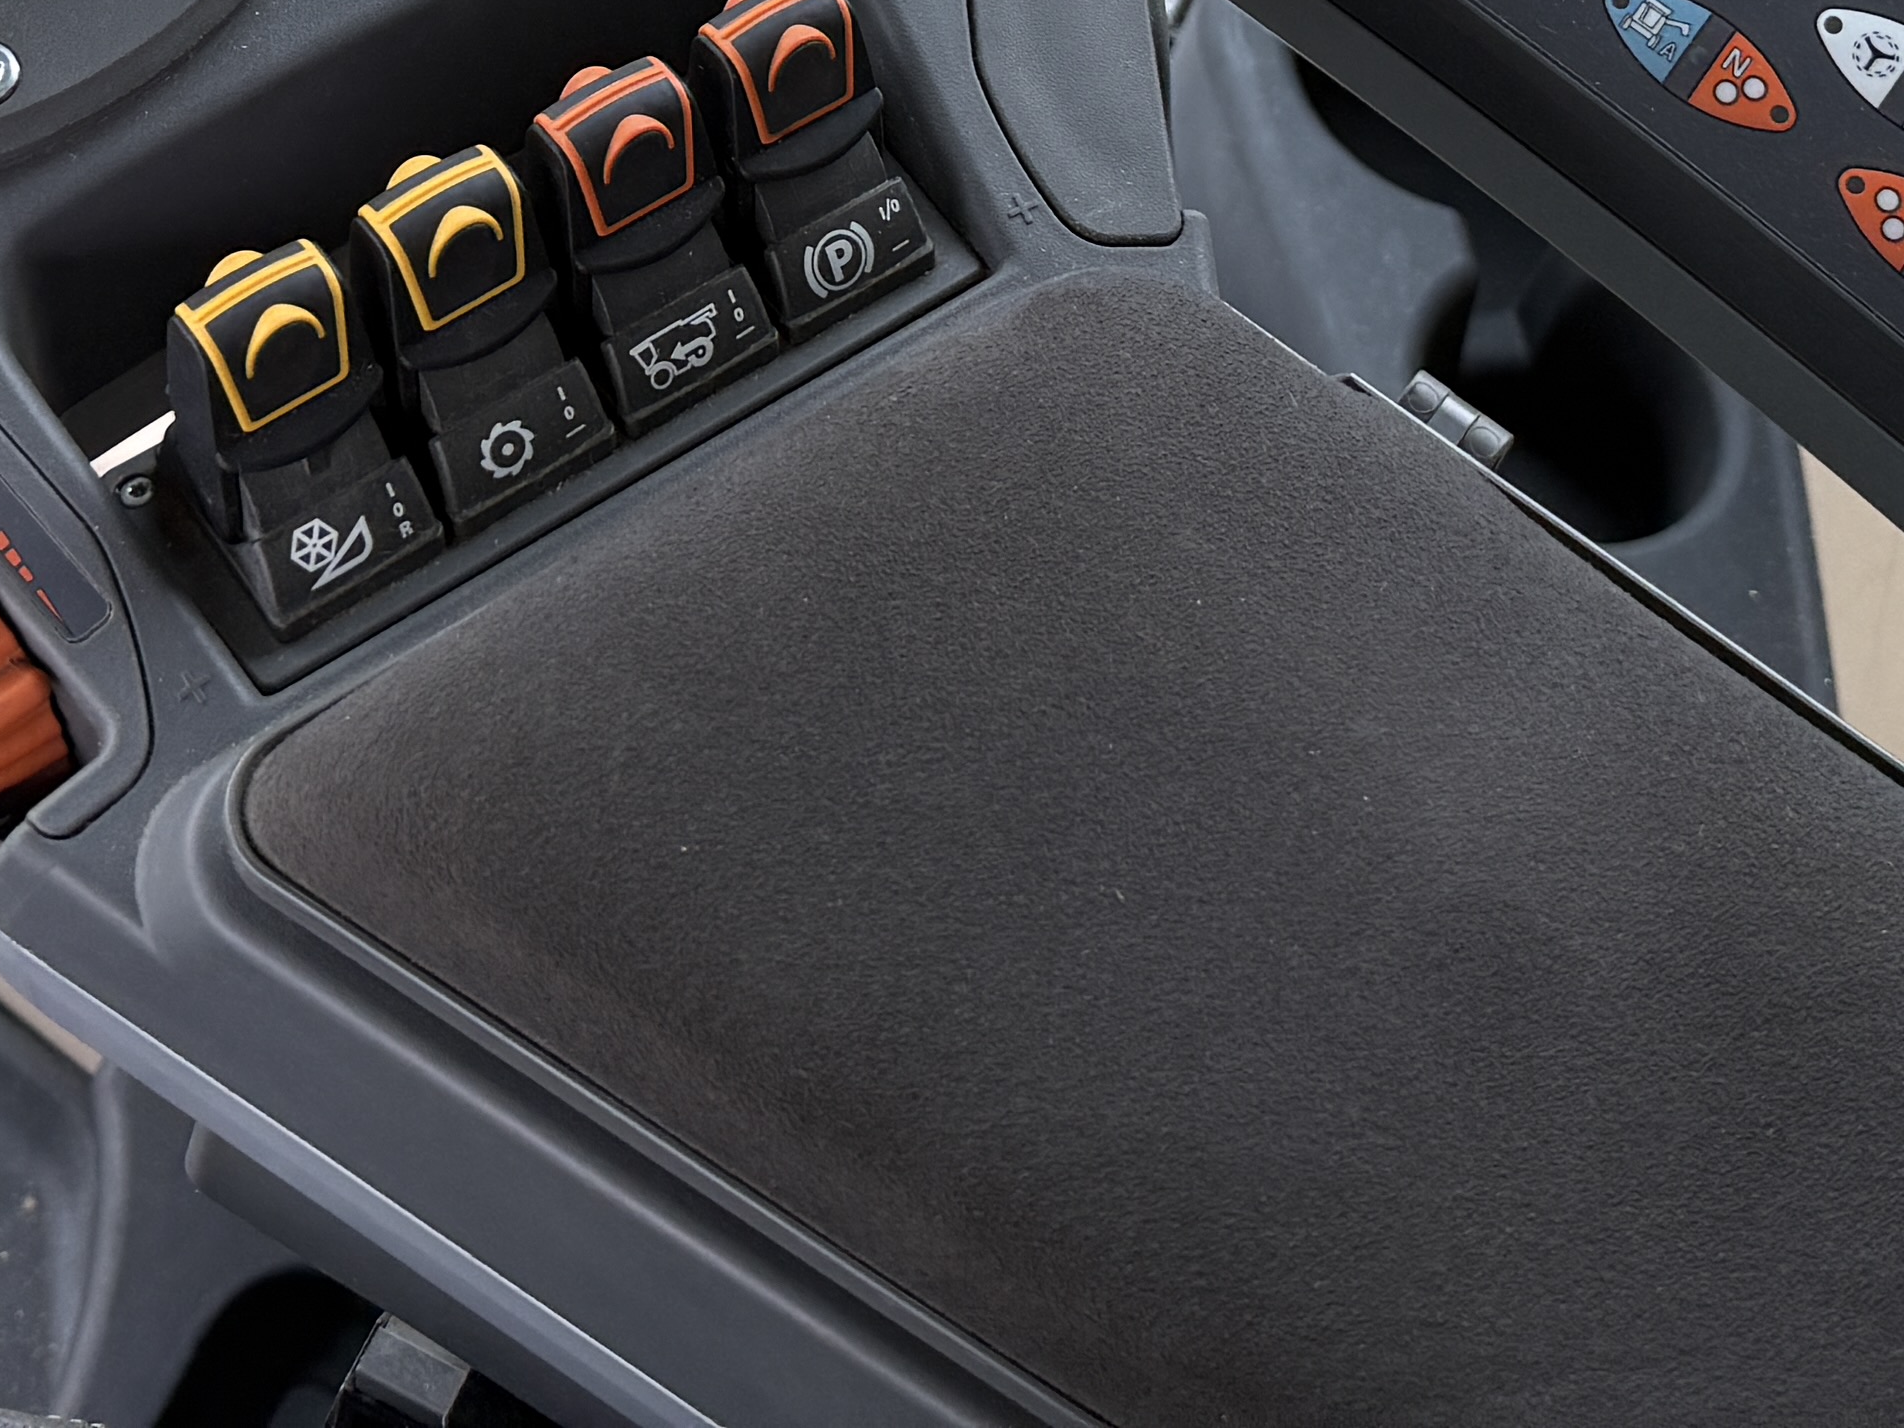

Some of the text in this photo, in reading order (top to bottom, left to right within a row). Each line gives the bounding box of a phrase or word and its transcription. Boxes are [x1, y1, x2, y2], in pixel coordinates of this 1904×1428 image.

[1658, 41, 1677, 63] A
[1721, 46, 1753, 79] N
[824, 238, 854, 283] P
